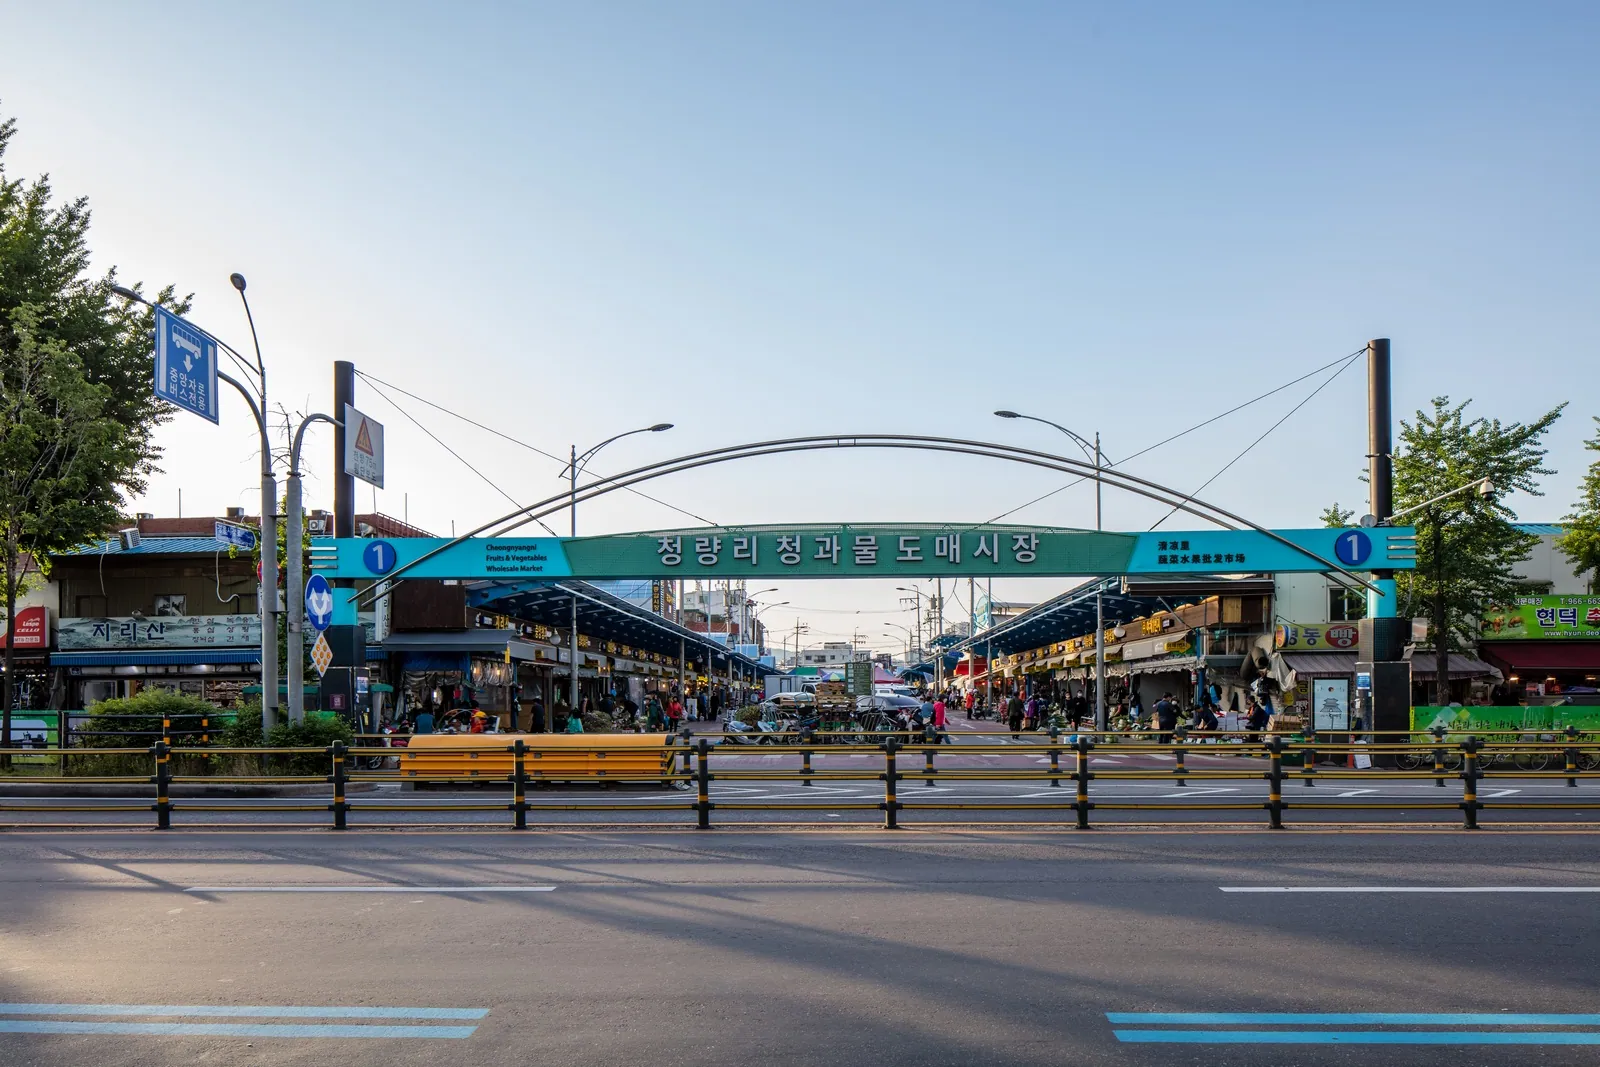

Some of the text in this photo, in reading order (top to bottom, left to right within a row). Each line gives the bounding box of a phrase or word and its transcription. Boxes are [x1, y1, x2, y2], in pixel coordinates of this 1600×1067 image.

[169, 383, 206, 411] 버스전용
[372, 544, 384, 570] 1
[485, 543, 537, 552] Cheongnyangni
[485, 554, 547, 562] Fruits & Vegetables
[657, 533, 1040, 565] 청량리 청과물 도매시장
[1346, 534, 1359, 561] 1
[1536, 607, 1578, 628] 현덕
[92, 622, 166, 641] 지리산
[1330, 627, 1357, 647] 빵
